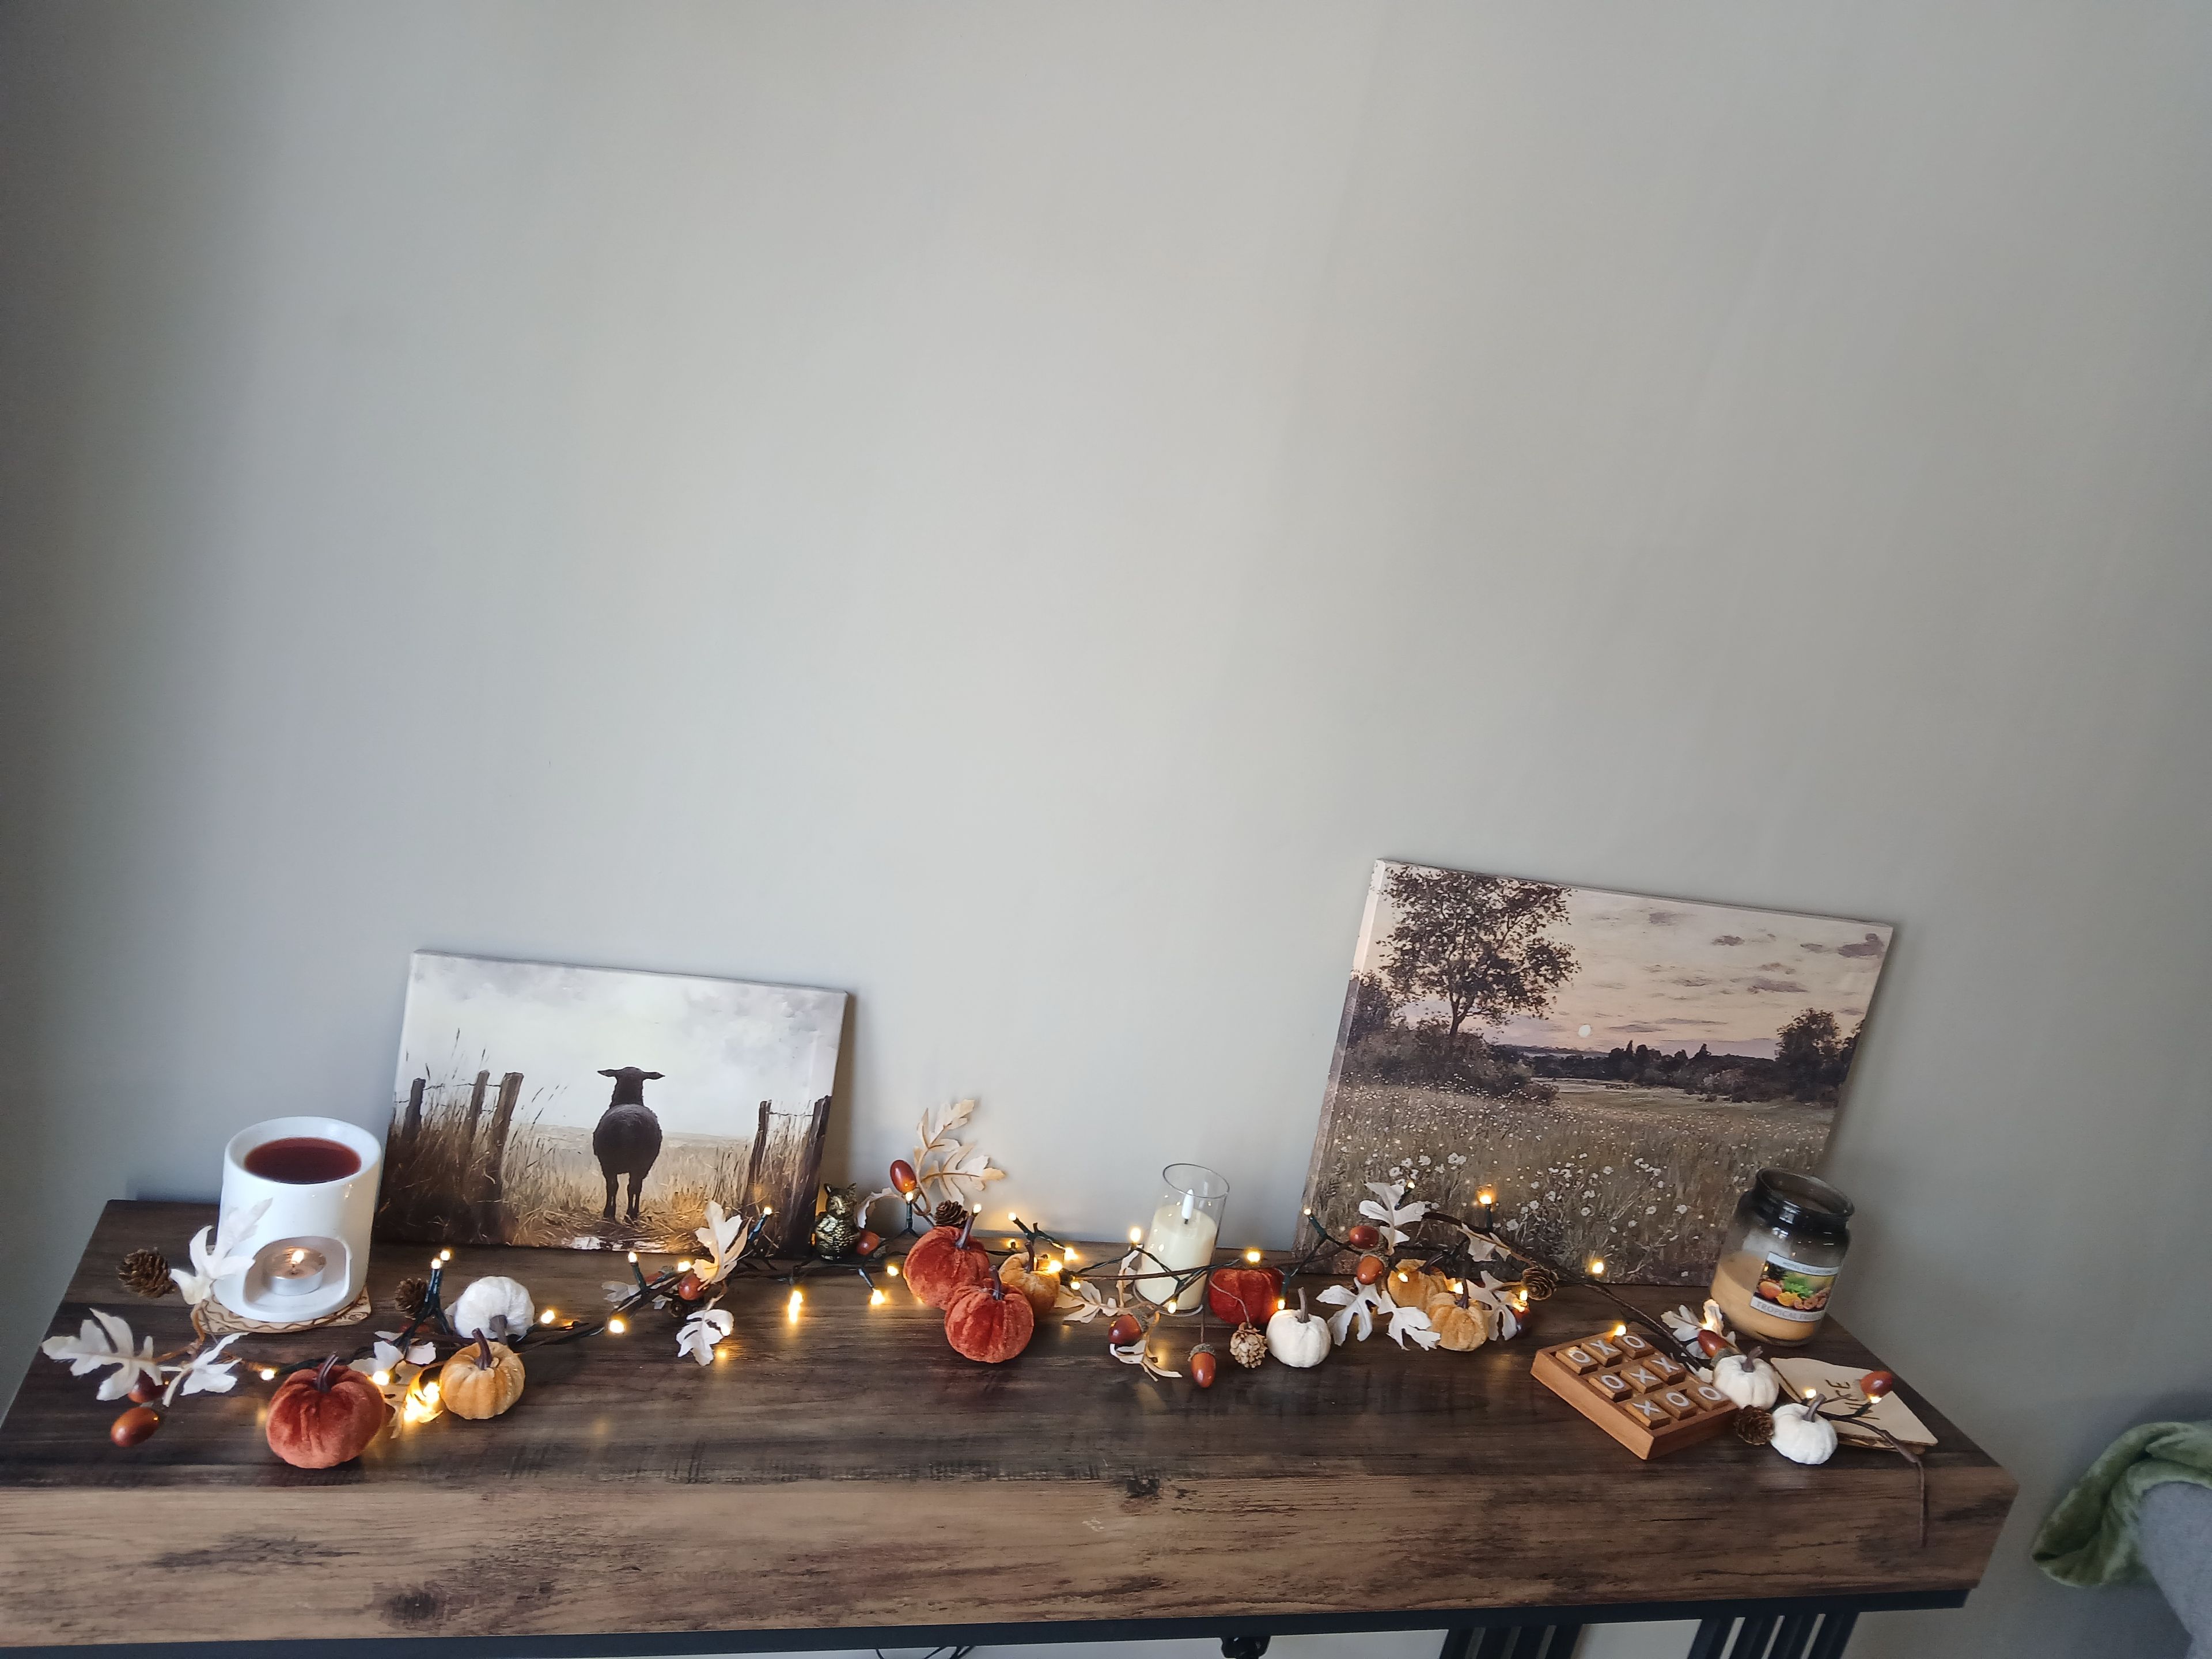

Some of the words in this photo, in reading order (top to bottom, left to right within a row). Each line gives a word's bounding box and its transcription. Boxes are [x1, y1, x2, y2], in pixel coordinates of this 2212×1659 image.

[1756, 1301, 1797, 1320] TROPICAL
[1590, 1339, 1618, 1355] X
[1630, 1368, 1658, 1384] X
[1651, 1357, 1679, 1373] X
[1631, 1400, 1661, 1416] X
